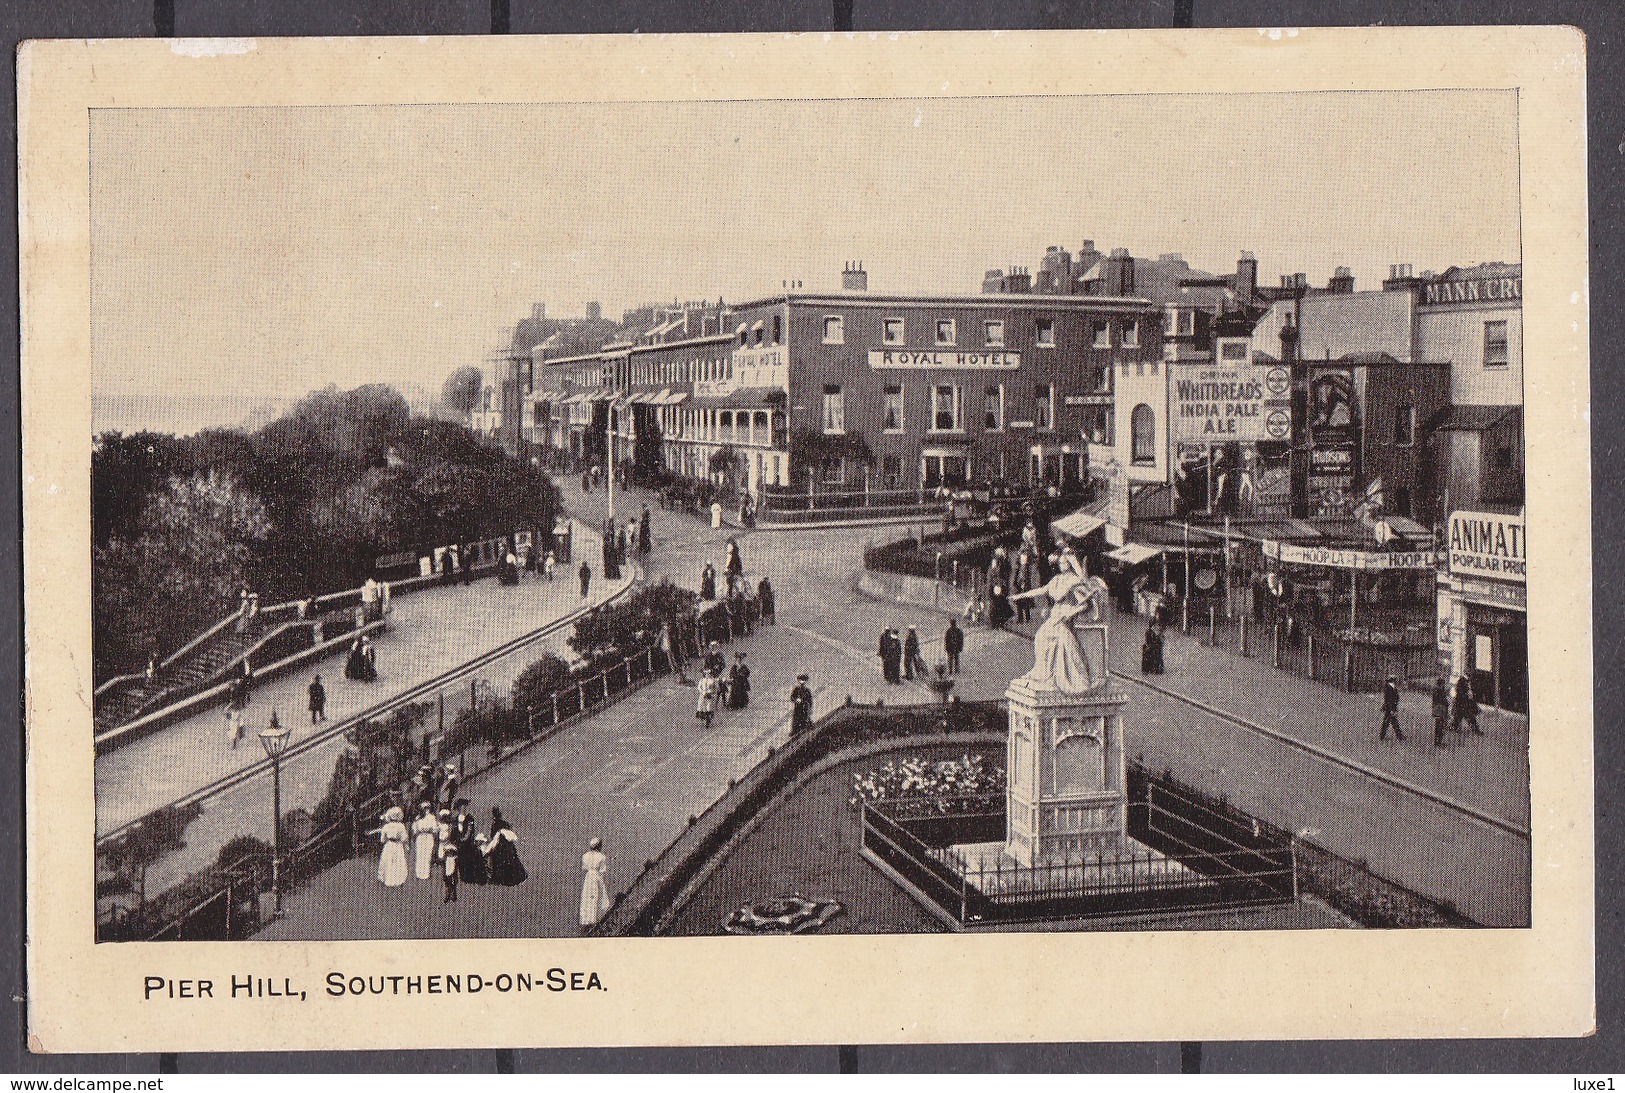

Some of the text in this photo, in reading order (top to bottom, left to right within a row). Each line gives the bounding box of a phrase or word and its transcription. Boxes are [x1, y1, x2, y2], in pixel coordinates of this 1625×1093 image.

[883, 352, 1013, 365] ROYAL HOTEL
[1200, 371, 1239, 380] DRINK
[1177, 378, 1263, 401] WHITBREAD'S
[1180, 403, 1220, 418] INDIA
[1226, 403, 1259, 418] PALE
[1203, 419, 1236, 434] ALE
[1450, 518, 1526, 560] ANIMAT
[1388, 552, 1422, 567] HOOP
[1452, 553, 1501, 571] POPULAR
[144, 967, 609, 1002] PIER HILL, SOUTHEND-ON-SEA.
